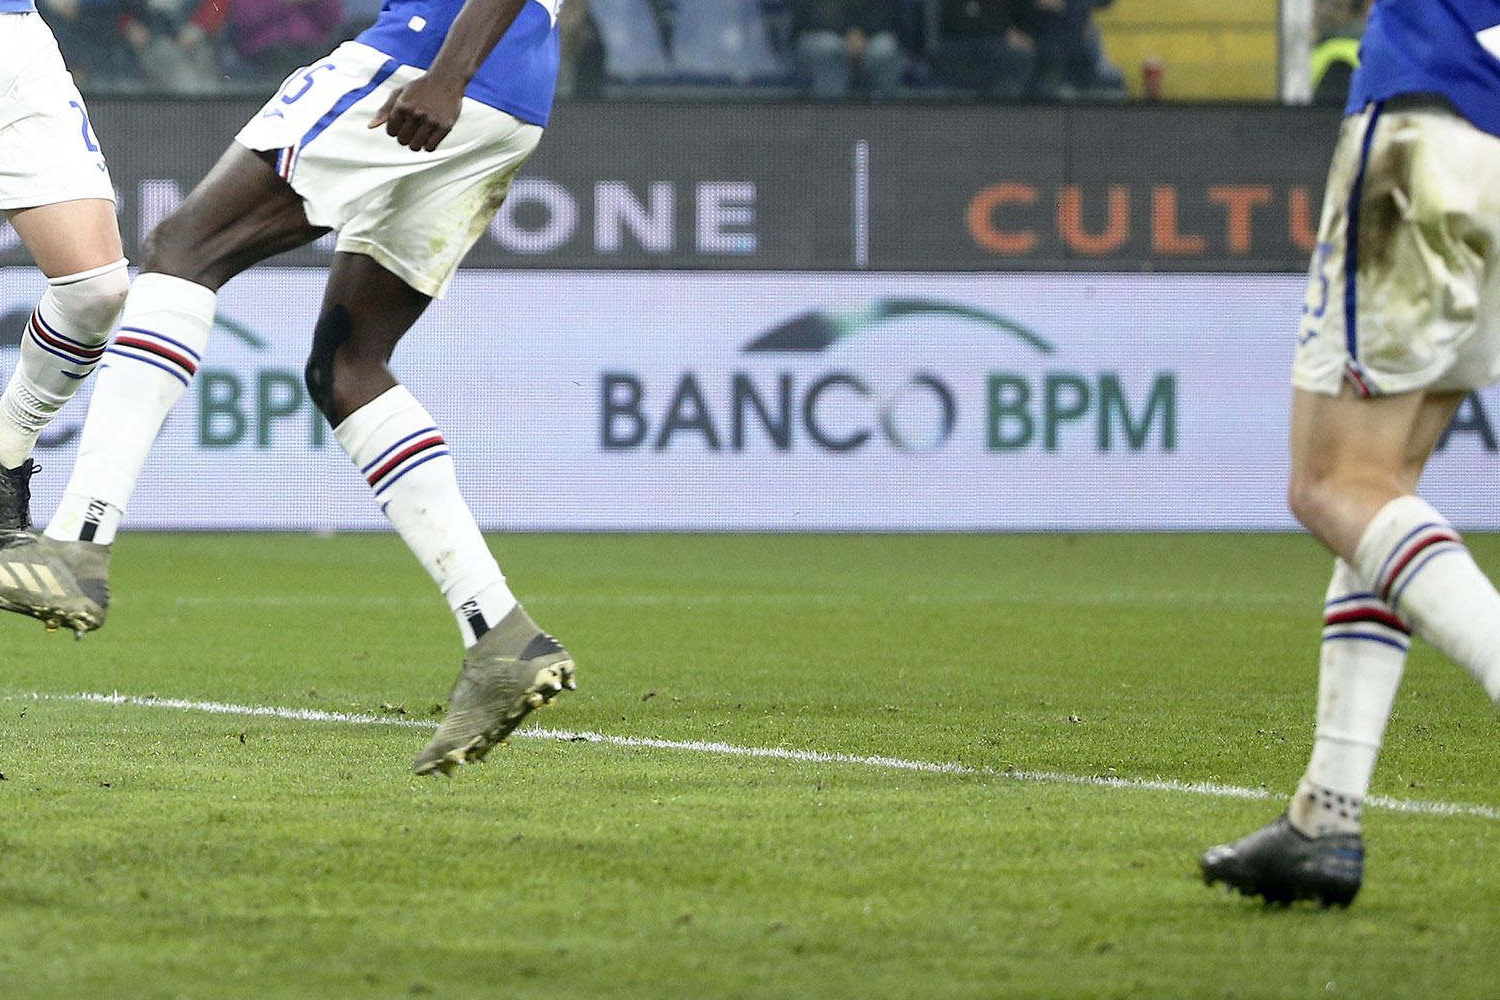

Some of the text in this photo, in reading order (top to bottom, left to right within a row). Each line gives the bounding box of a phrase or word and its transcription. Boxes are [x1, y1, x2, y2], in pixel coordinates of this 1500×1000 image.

[198, 370, 325, 448] BP
[601, 368, 1177, 452] BANCO BPM
